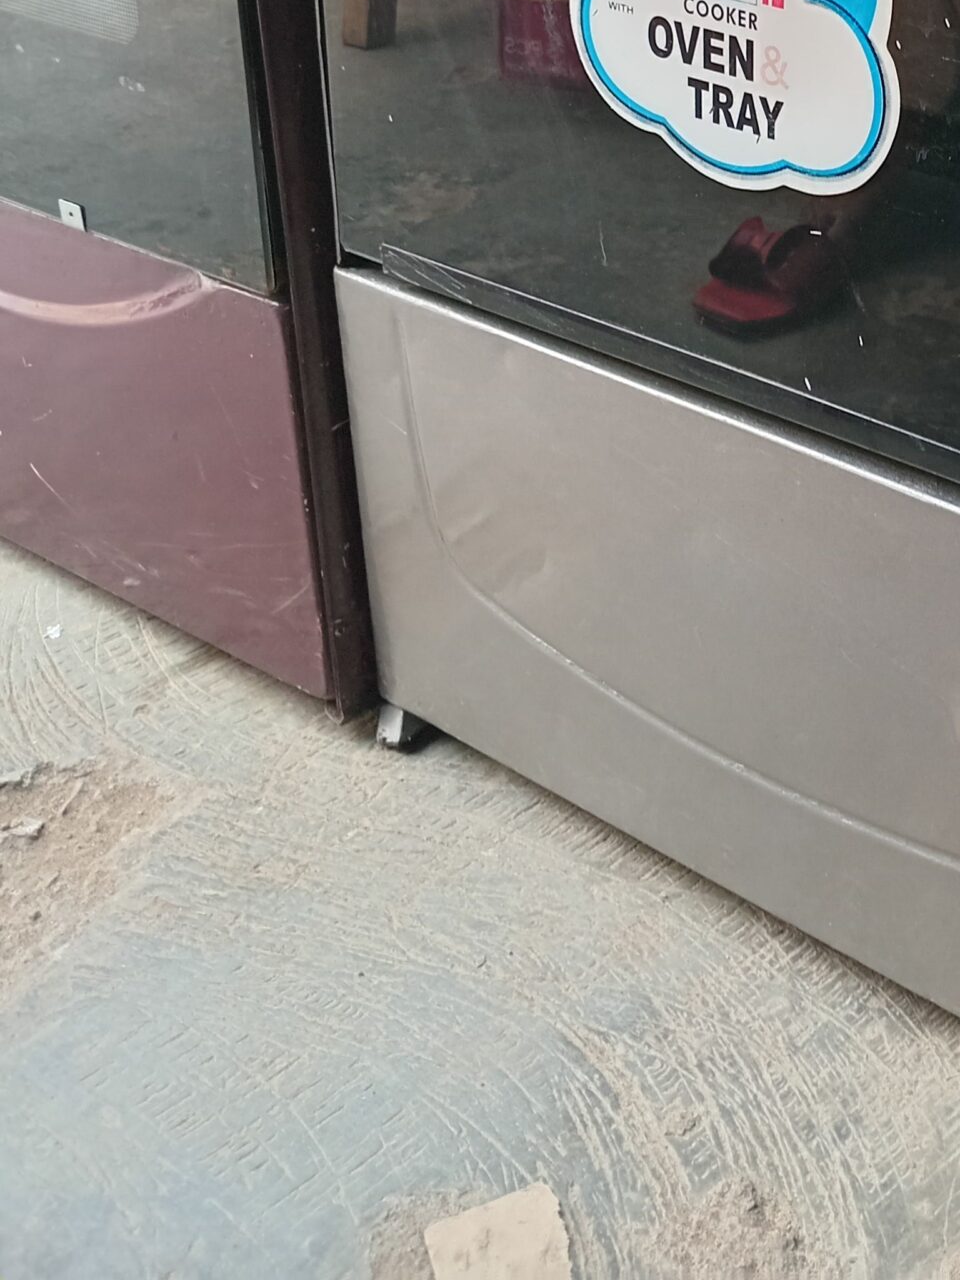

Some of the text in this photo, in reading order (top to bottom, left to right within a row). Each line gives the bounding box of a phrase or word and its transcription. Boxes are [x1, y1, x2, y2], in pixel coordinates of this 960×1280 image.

[608, 1, 634, 15] WITH
[647, 15, 789, 90] OVEN &
[687, 76, 785, 141] TRAY
